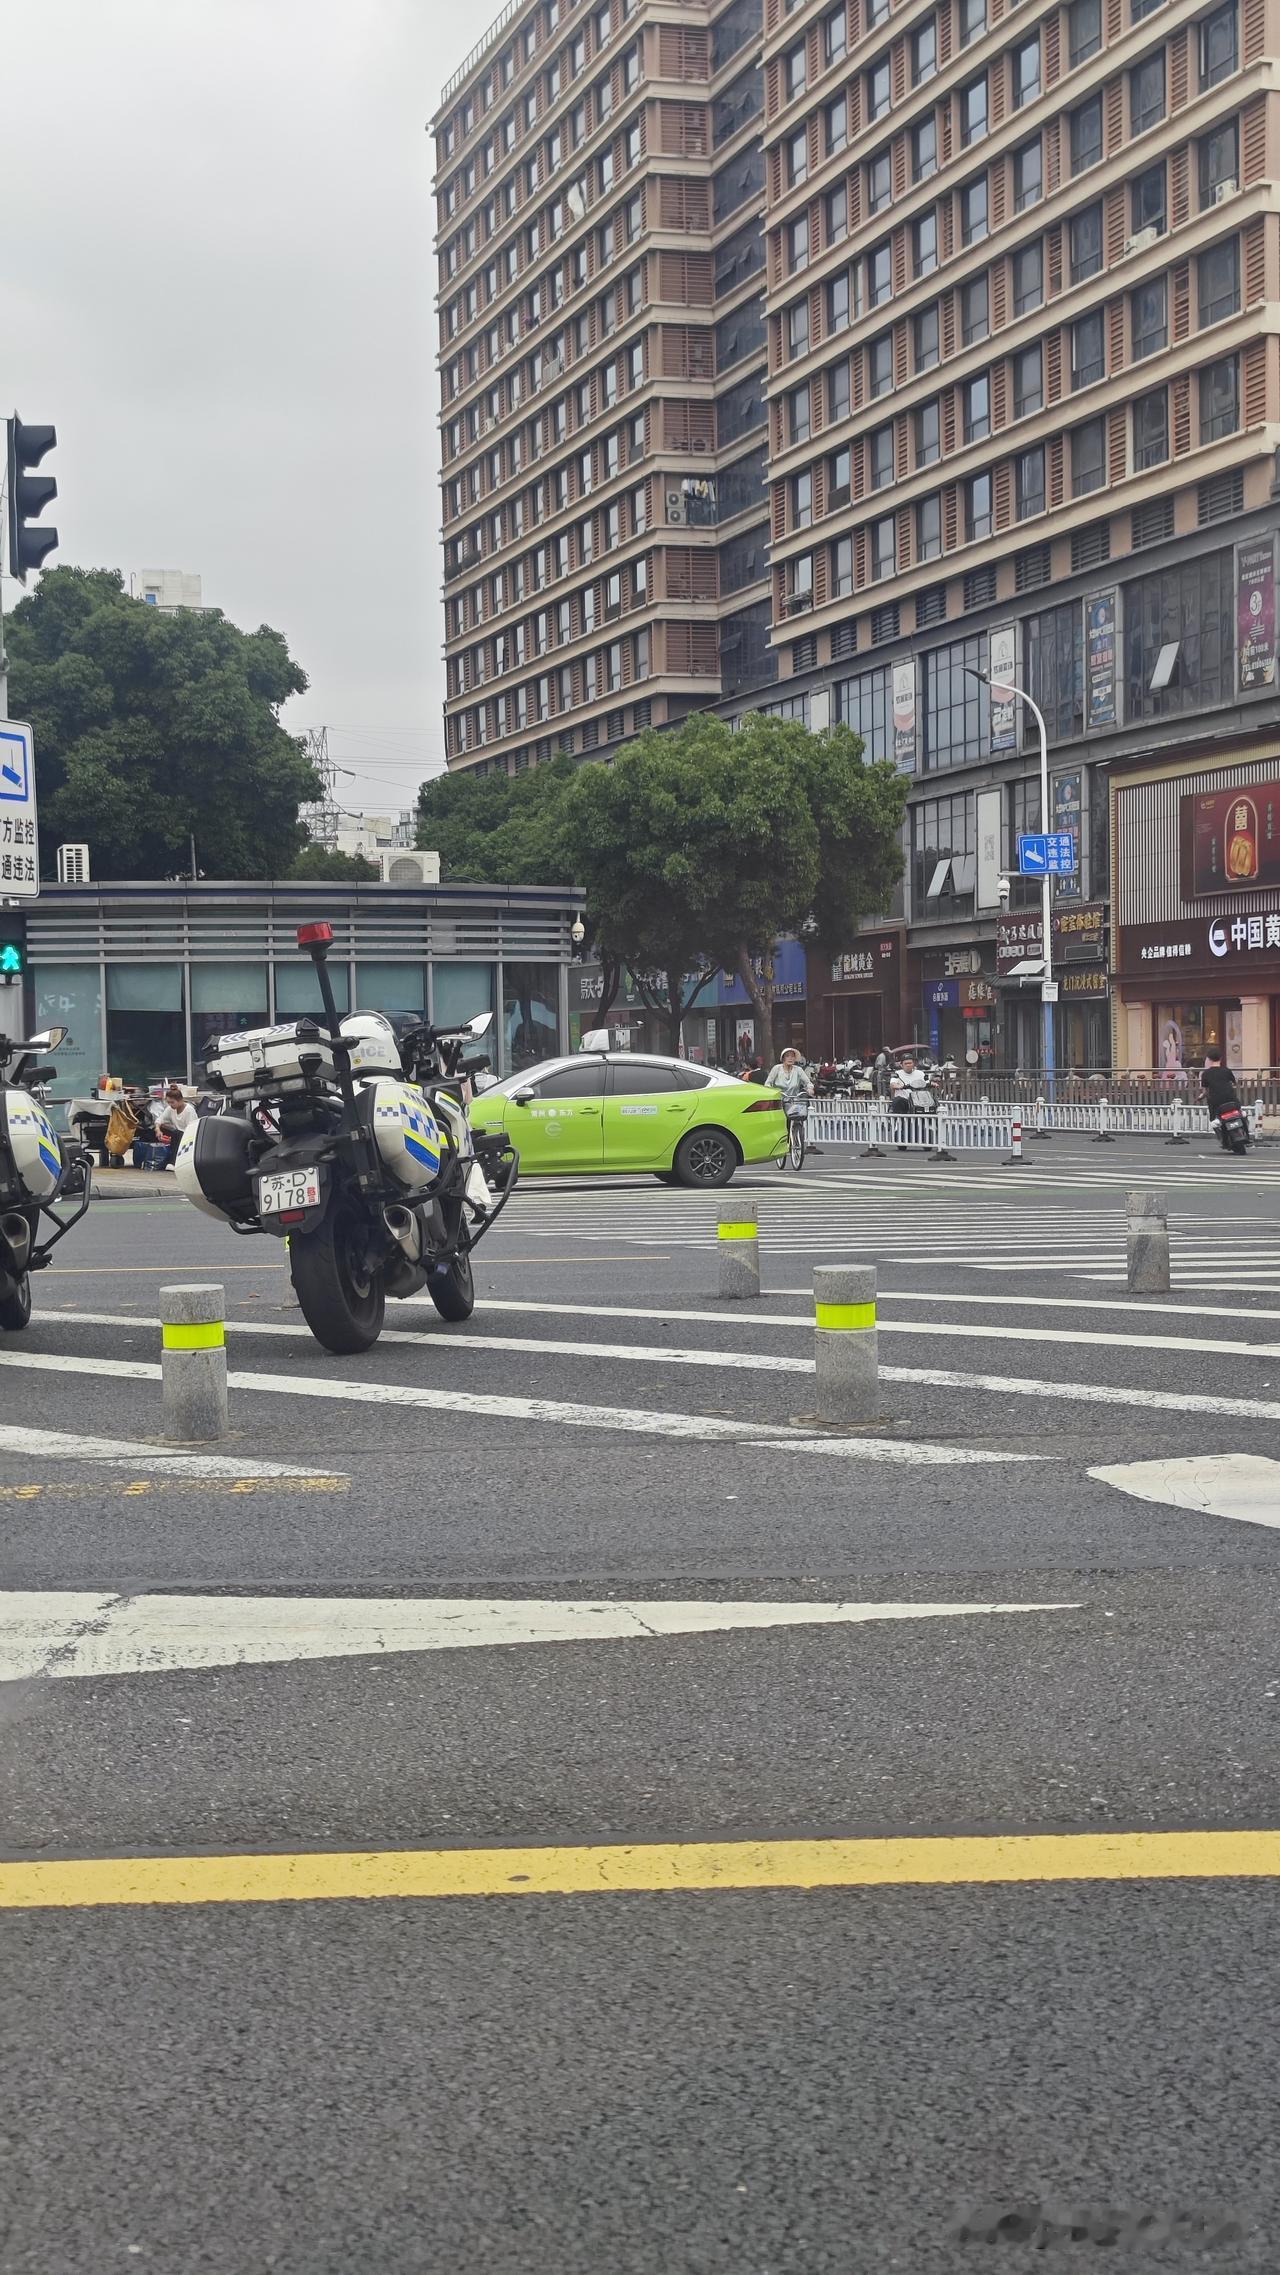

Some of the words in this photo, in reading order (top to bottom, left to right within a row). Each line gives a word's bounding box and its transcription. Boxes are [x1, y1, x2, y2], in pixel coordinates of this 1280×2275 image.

[0, 817, 35, 845] 方监控
[1047, 837, 1070, 847] 交通
[1048, 847, 1071, 858] 违法
[2, 854, 35, 882] 通违法
[1048, 859, 1072, 870] 监控
[1231, 914, 1280, 951] 中国黄
[271, 1172, 306, 1191] 苏·D
